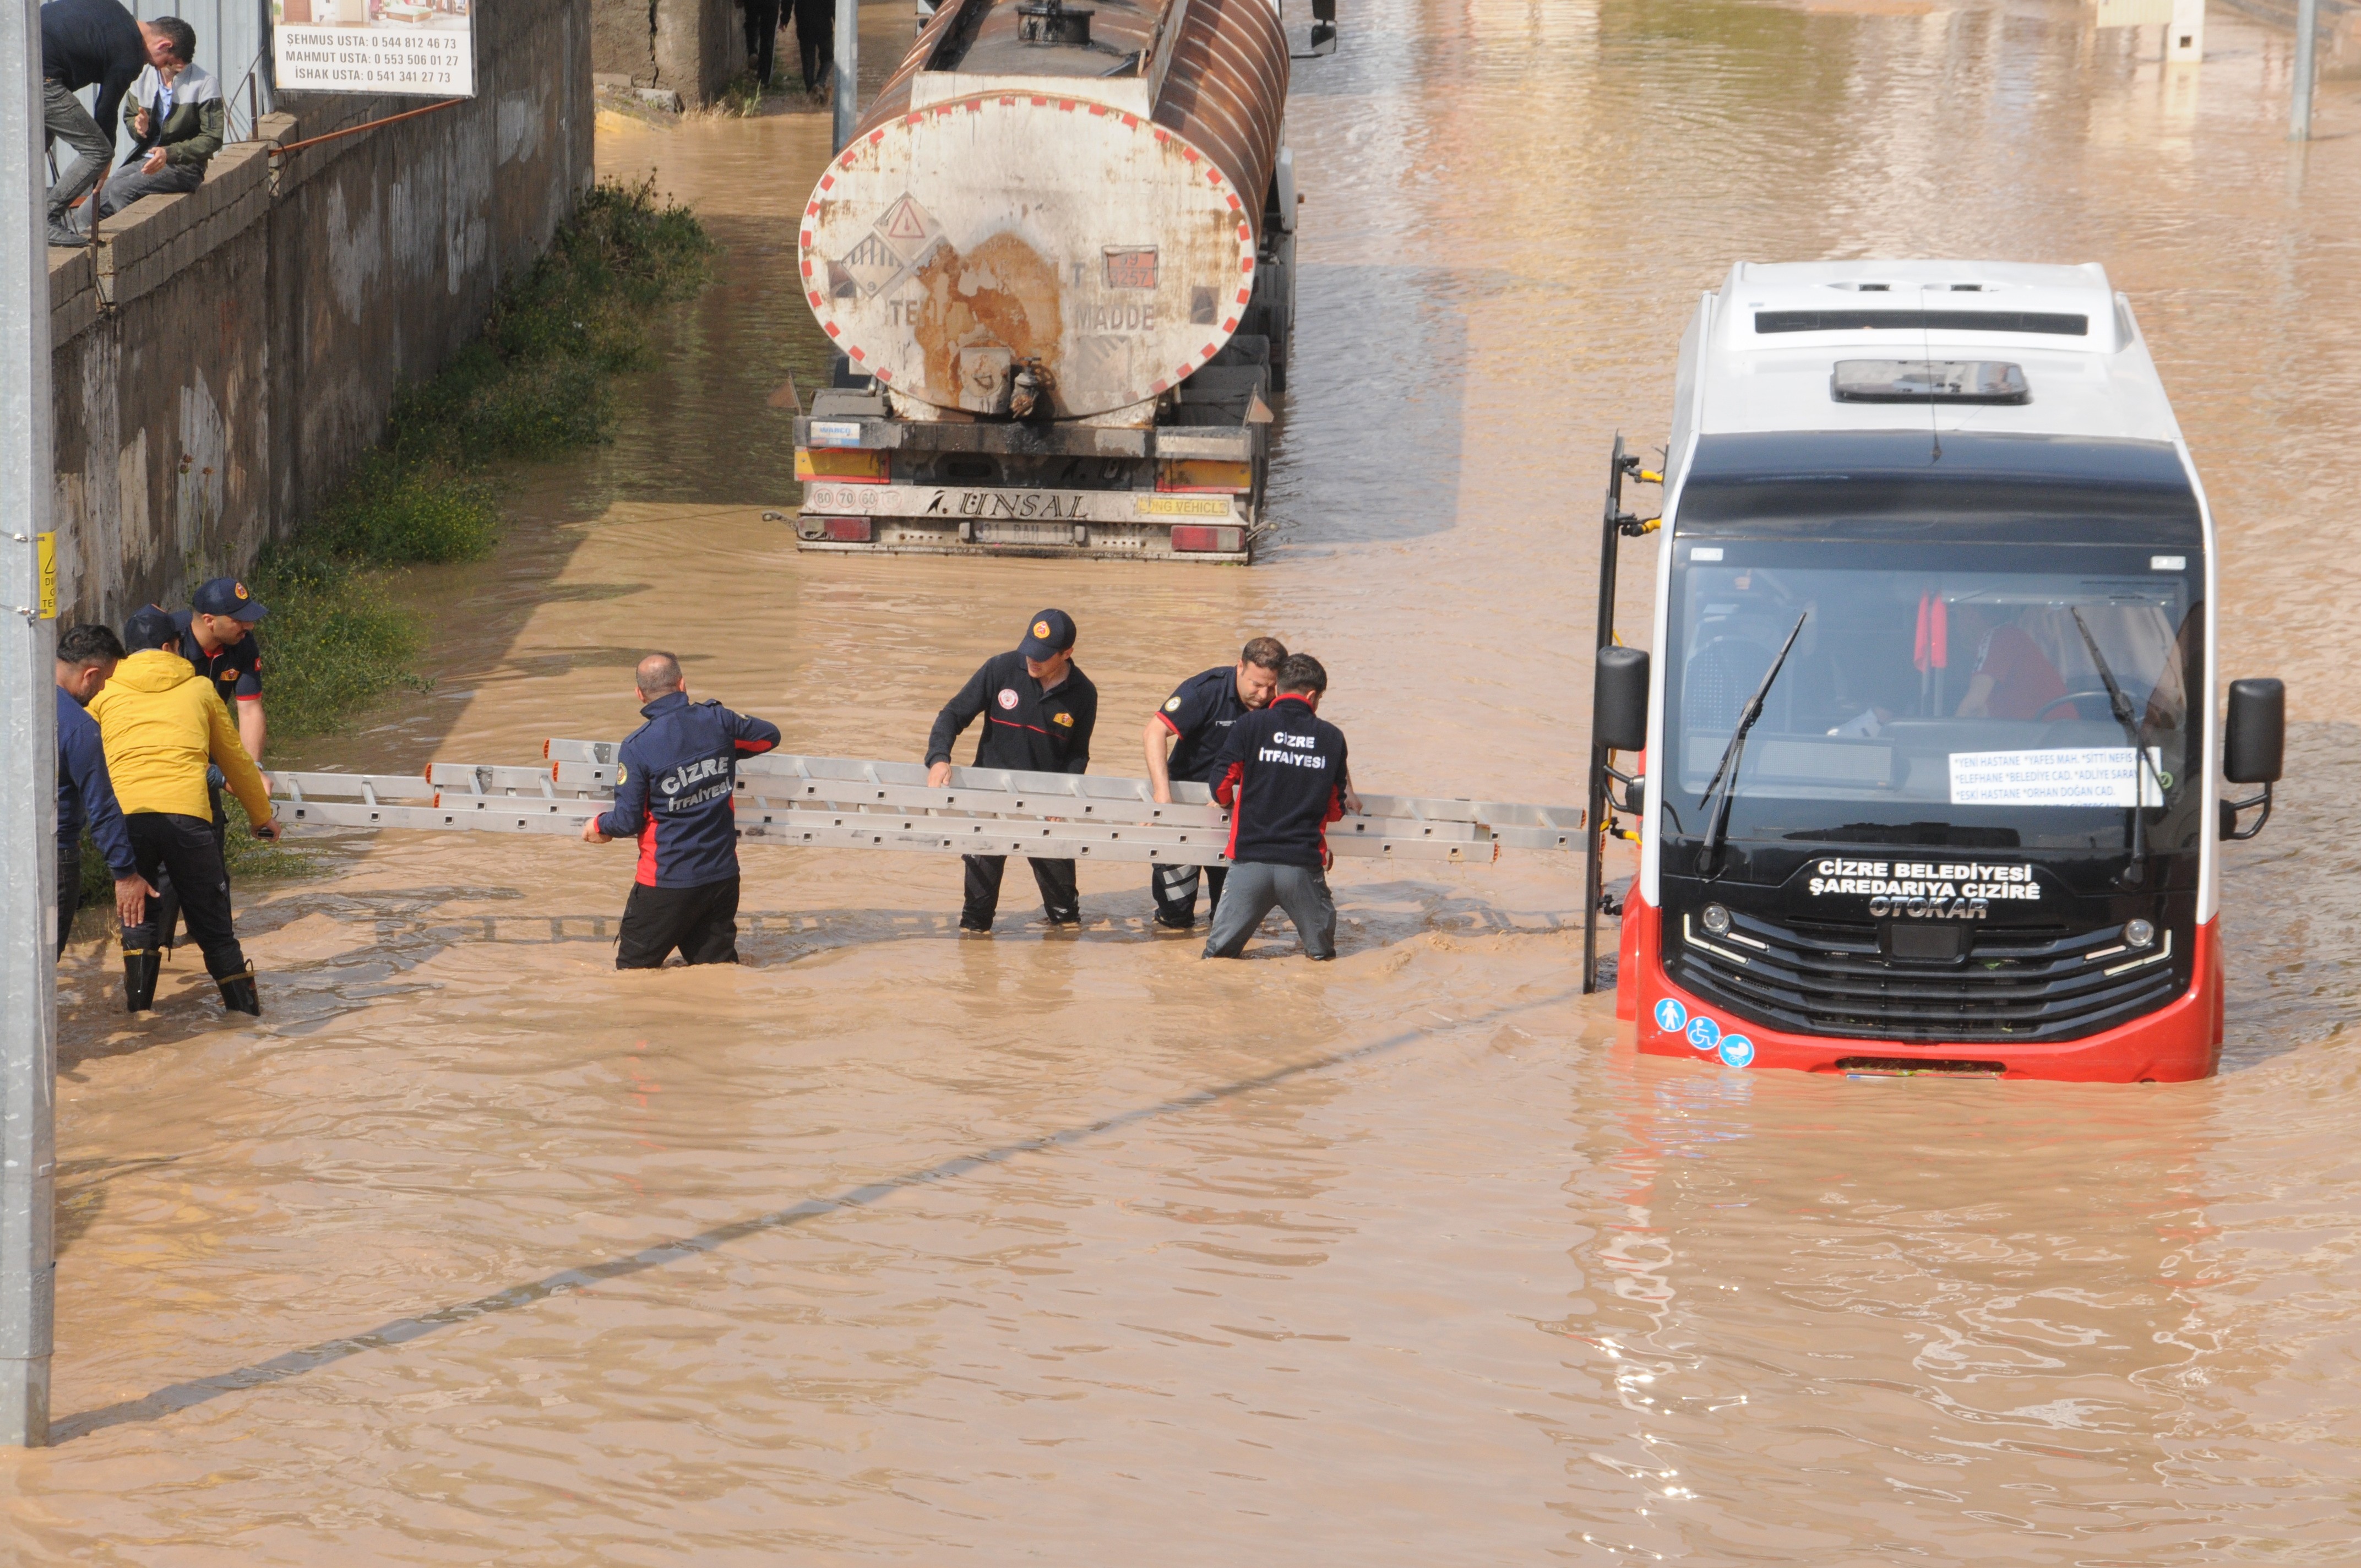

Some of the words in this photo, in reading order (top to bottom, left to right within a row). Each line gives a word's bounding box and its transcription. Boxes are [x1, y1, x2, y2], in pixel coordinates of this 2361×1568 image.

[287, 34, 334, 46] ŞEHMUS
[338, 36, 368, 47] USTA:
[372, 36, 378, 47] 0
[382, 37, 401, 47] 544
[405, 37, 423, 48] 812
[427, 38, 440, 48] 46
[444, 39, 456, 49] 73
[286, 51, 336, 62] MAHMUT
[340, 53, 371, 63] USTA:
[374, 53, 380, 64] 0
[385, 54, 404, 64] 553
[407, 55, 427, 65] 506
[431, 55, 441, 66] 01
[446, 56, 458, 66] 27
[295, 66, 329, 79] İSHAK
[333, 69, 363, 81] USTA:
[367, 70, 373, 81] 0
[377, 71, 395, 81] 541
[399, 72, 416, 82] 341
[422, 72, 433, 82] 27
[439, 72, 450, 83] 73
[1075, 303, 1155, 330] MADDE
[819, 426, 851, 434] WABCO
[817, 493, 831, 503] 80
[840, 493, 853, 504] 70
[862, 493, 875, 504] 60
[960, 492, 1089, 518] ÜNSAL
[1273, 732, 1315, 749] CİZRE
[1259, 747, 1326, 769] İTFAİYESİ
[1981, 756, 2021, 767] HASTANE
[2057, 754, 2080, 764] MAH.
[2109, 751, 2133, 763] NEFİS
[661, 757, 729, 794] CİZRE
[2052, 771, 2072, 780] CAD.
[1982, 788, 2021, 800] HASTANE
[2061, 785, 2093, 797] DOĞAN
[2095, 786, 2116, 796] CAD.
[1818, 859, 1888, 876] CİZRE
[1895, 863, 2032, 882] BELEDİYESİ
[1809, 878, 1956, 897] ŞAREDARIYA
[1869, 896, 1989, 919] OTOKAR
